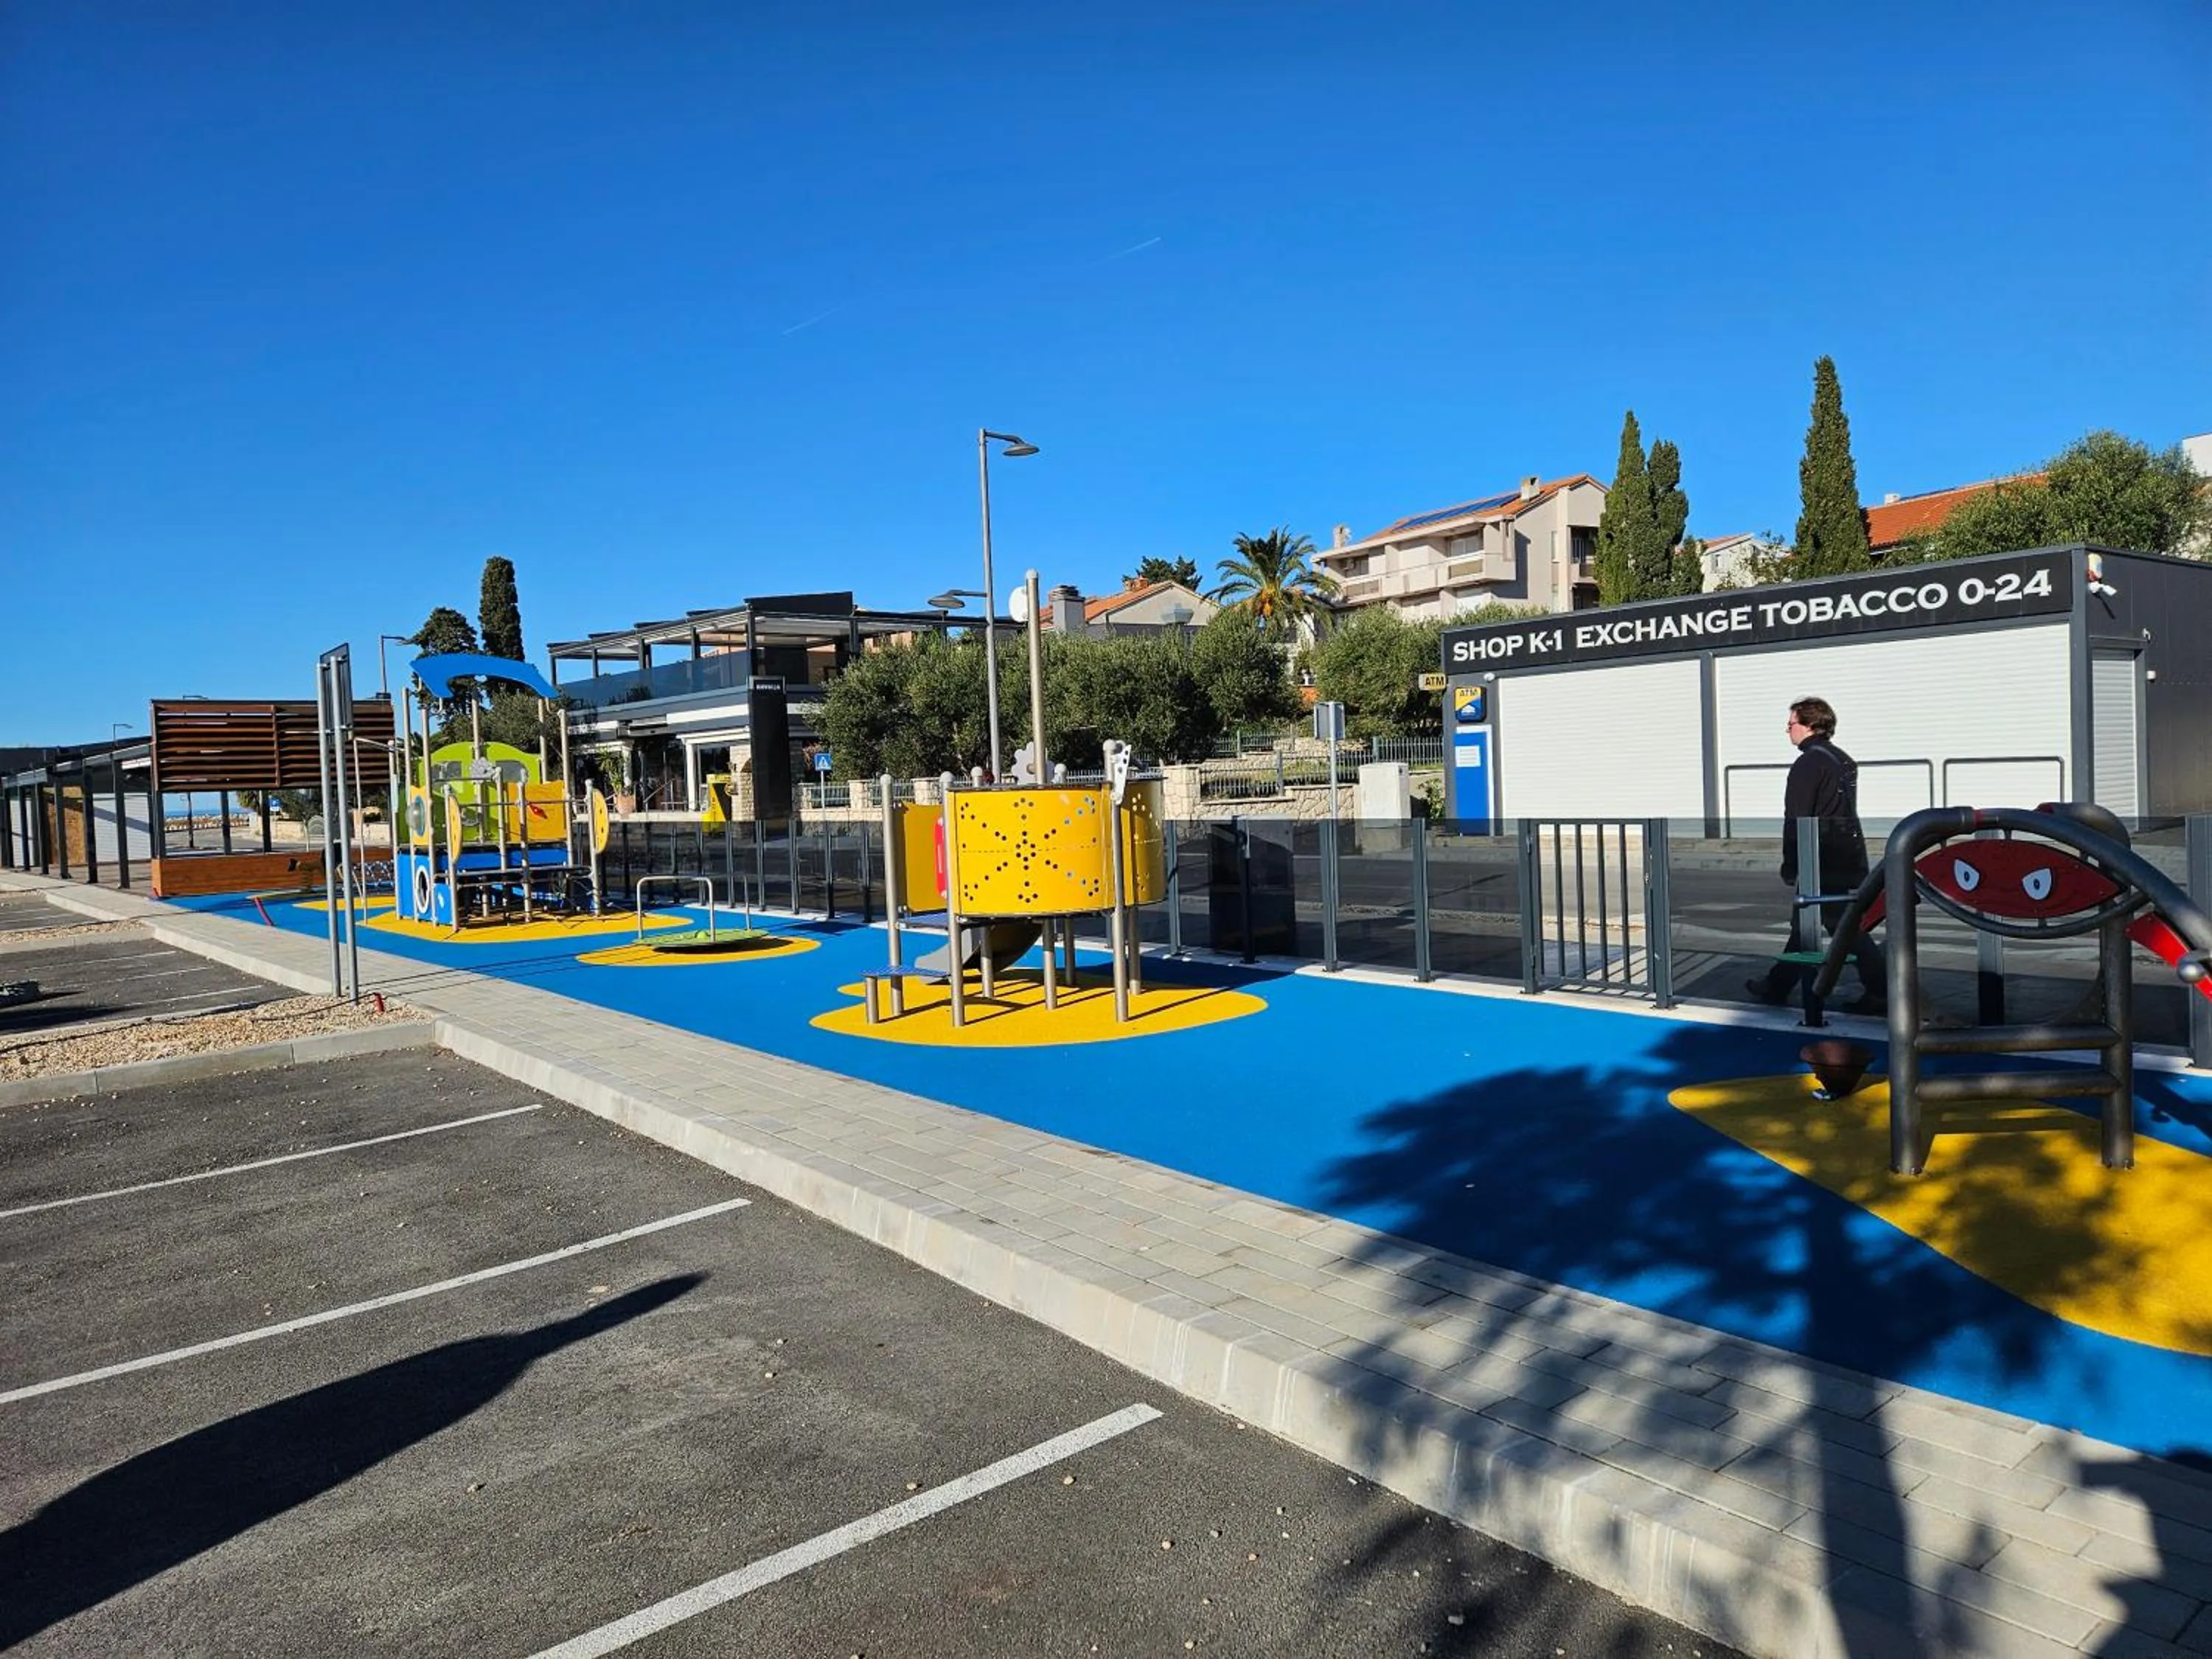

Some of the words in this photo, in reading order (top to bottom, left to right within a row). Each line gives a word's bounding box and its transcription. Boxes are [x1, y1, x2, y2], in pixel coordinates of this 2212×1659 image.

[1453, 636, 1523, 661] SHOP
[1529, 630, 1562, 654] K-1
[1576, 605, 1753, 649] EXCHANGE
[1759, 583, 1949, 627] TOBACCO
[1958, 569, 2052, 605] 0-24
[1425, 676, 1444, 685] ATM
[1459, 688, 1478, 697] ATM
